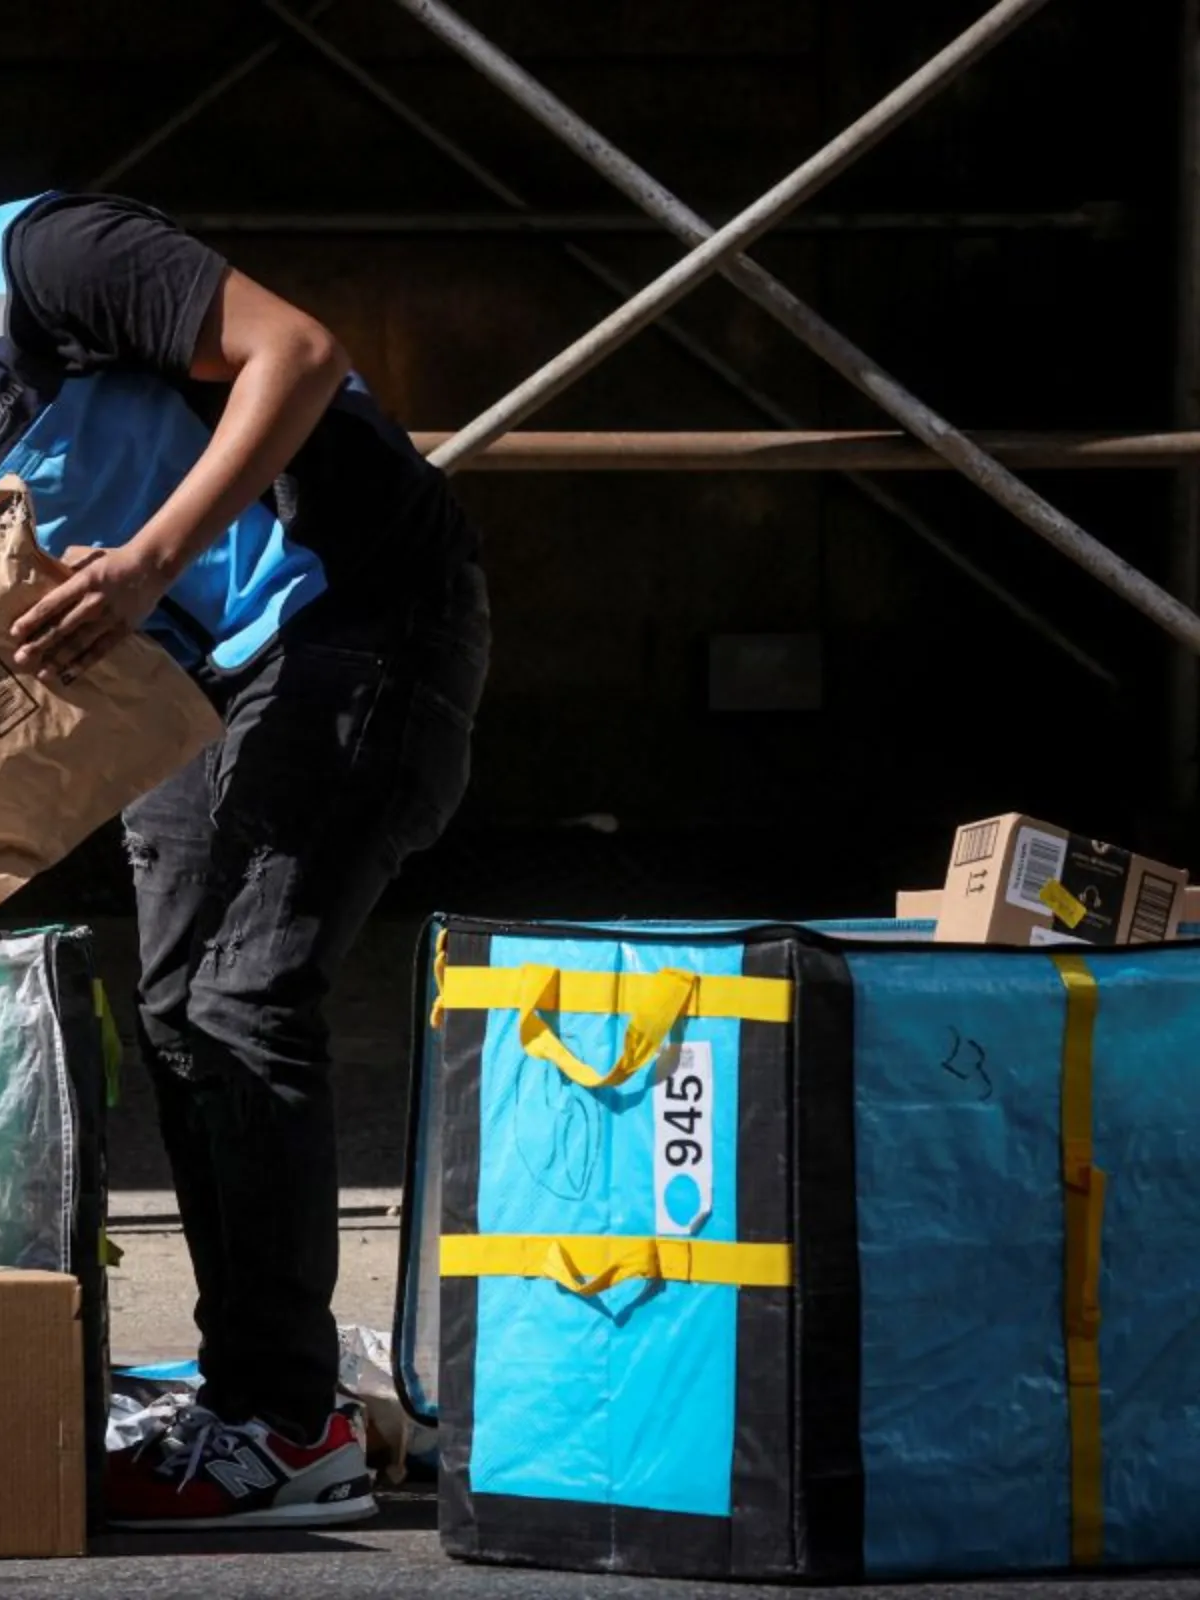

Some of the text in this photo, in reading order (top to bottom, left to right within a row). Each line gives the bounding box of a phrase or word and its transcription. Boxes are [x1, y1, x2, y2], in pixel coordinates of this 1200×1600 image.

[663, 1074, 704, 1167] 945
[205, 1446, 278, 1499] N
[327, 1482, 352, 1501] NB
